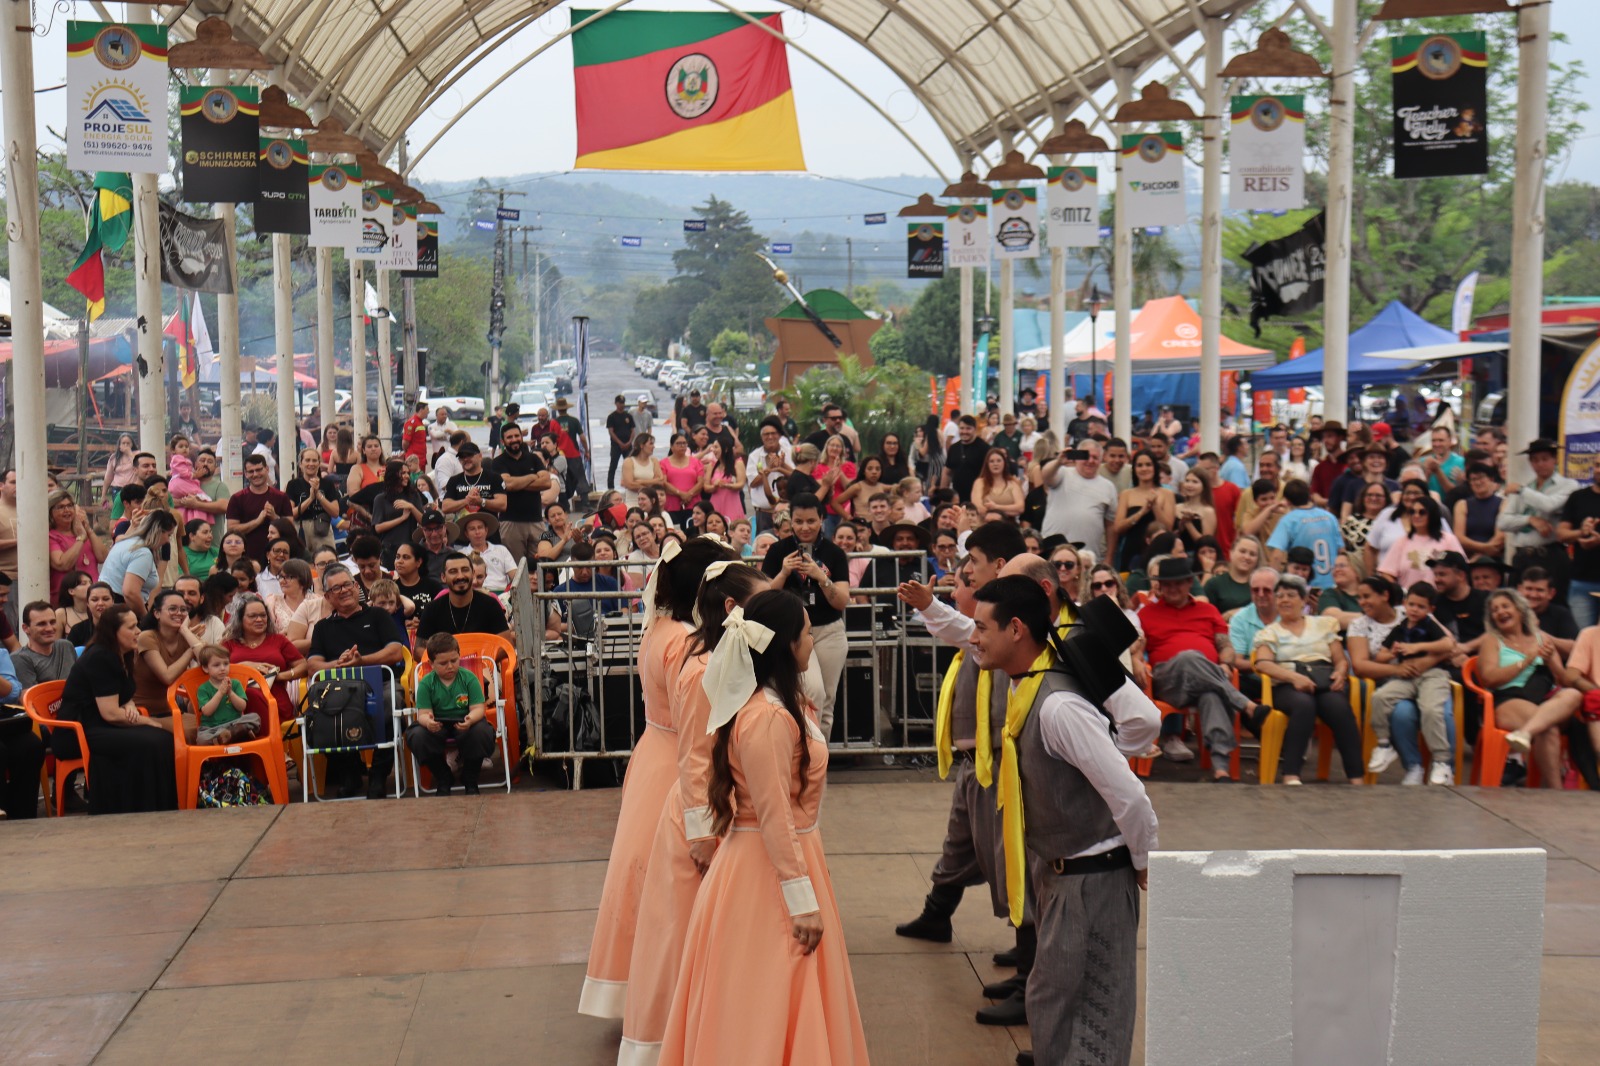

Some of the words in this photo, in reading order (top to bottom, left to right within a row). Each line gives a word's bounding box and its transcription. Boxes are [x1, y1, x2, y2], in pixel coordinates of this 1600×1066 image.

[84, 122, 152, 135] PROJESUL
[83, 132, 122, 141] ENERGIA
[124, 134, 153, 142] SOLAR
[83, 140, 99, 149] (51)
[132, 143, 153, 151] 9476
[199, 151, 257, 161] SCHIRMER
[199, 160, 257, 168] IMUNIZADORA
[1141, 180, 1180, 191] SICOOB
[1243, 176, 1290, 193] REIS
[261, 191, 286, 199] RUPO
[314, 207, 356, 218] TARDETTI
[1062, 206, 1092, 223] MTZ
[1314, 539, 1330, 574] 9
